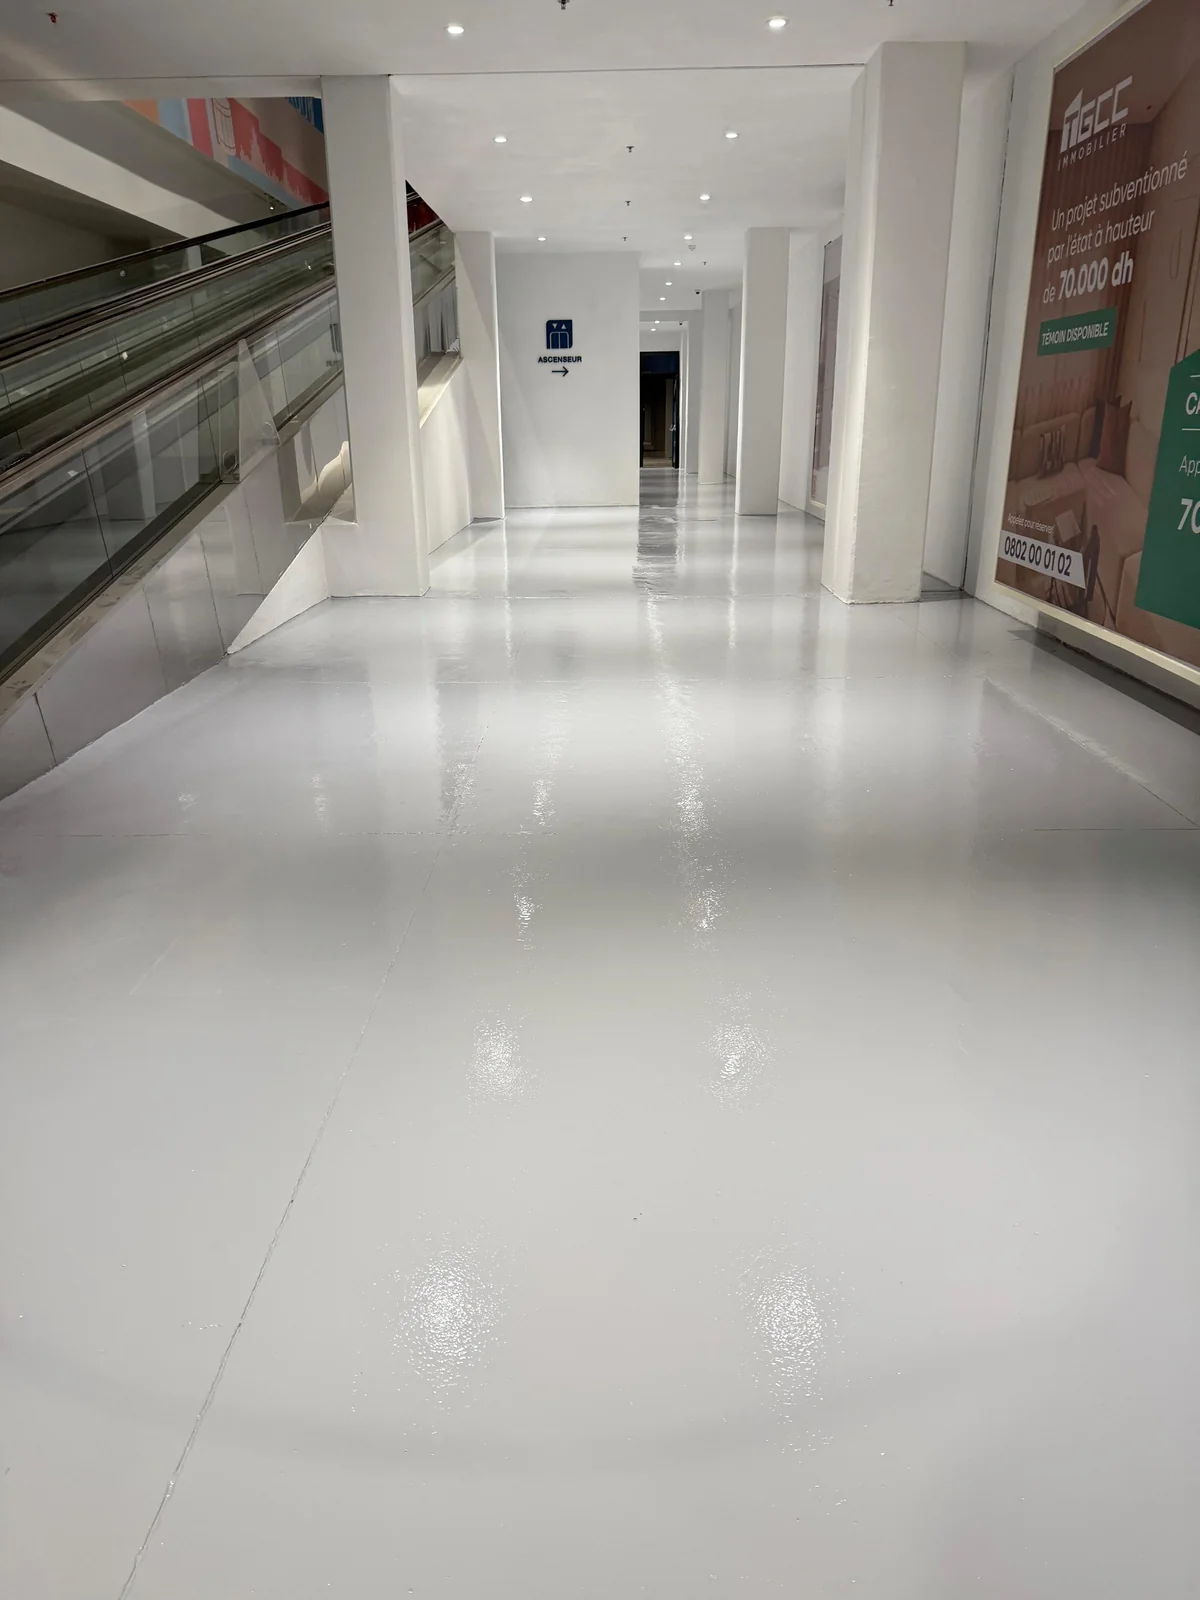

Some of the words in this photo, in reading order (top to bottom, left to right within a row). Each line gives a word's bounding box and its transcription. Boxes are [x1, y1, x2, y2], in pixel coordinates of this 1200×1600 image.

[1057, 122, 1127, 171] IMMOBILIER
[1052, 208, 1065, 231] Un
[1065, 193, 1098, 231] projet
[1099, 150, 1188, 212] subventionné
[1046, 243, 1066, 270] par
[1066, 229, 1093, 258] l'état
[1094, 223, 1103, 248] à
[1105, 210, 1156, 244] hauteur
[1042, 282, 1056, 304] de
[1058, 257, 1109, 300] 70.000
[1111, 250, 1134, 287] dh
[1041, 328, 1067, 346] TÉMOIN
[1066, 322, 1110, 342] DISPONIBLE
[538, 355, 583, 364] ASCENSEUR
[1024, 519, 1036, 529] pour
[1035, 520, 1055, 534] réserver
[1004, 536, 1027, 561] 0802
[1028, 543, 1042, 567] 00
[1044, 548, 1056, 572] 01
[1057, 552, 1072, 577] 02
